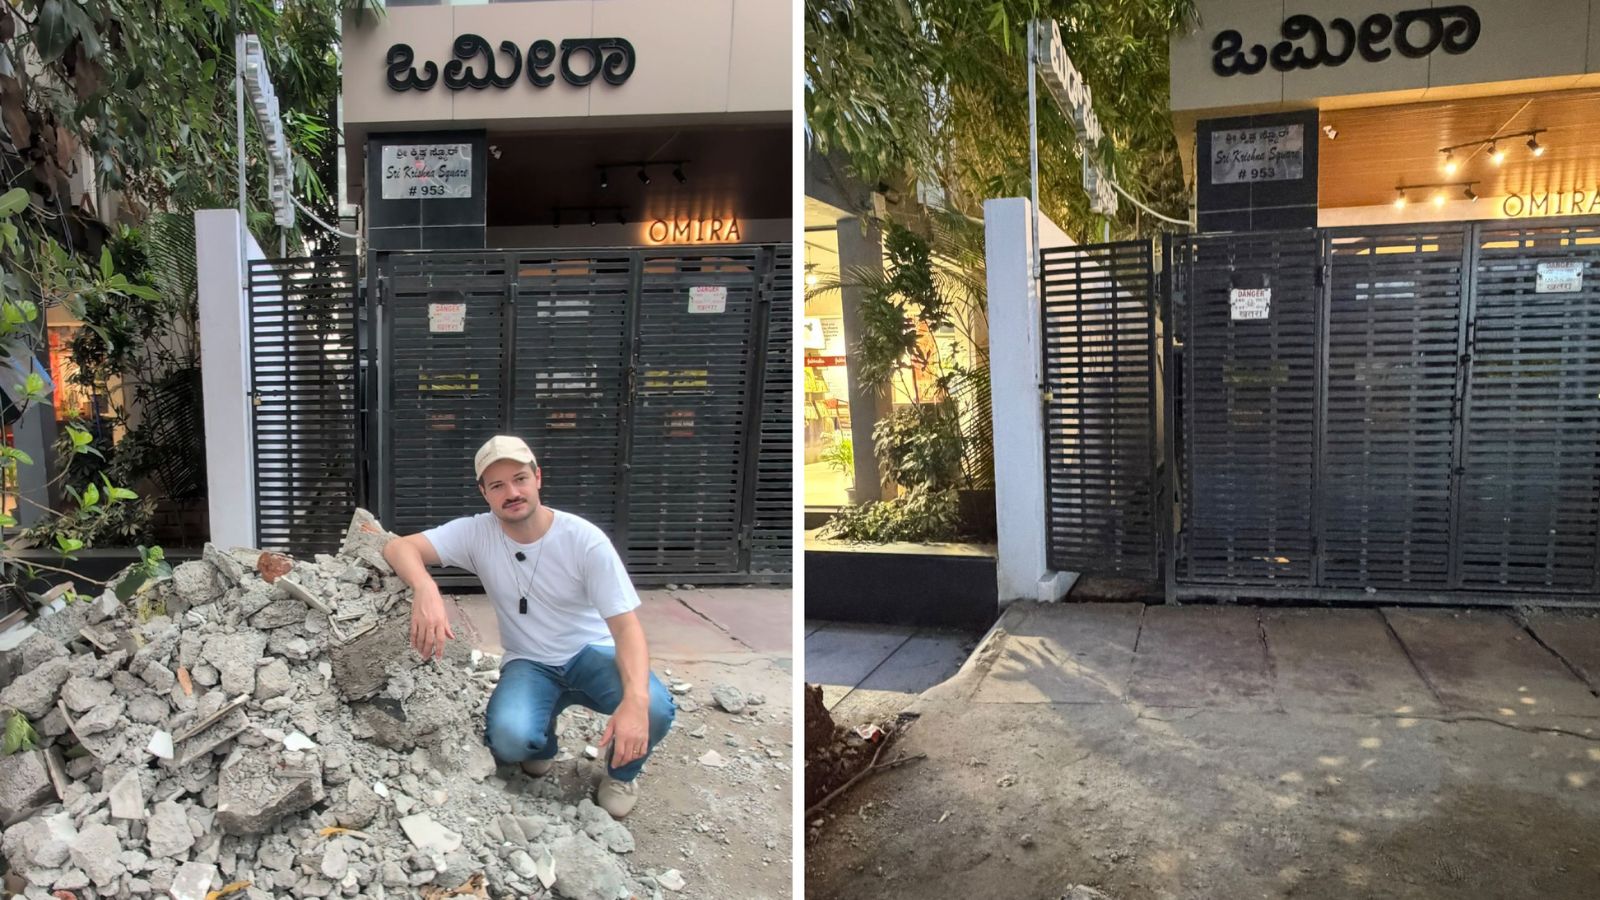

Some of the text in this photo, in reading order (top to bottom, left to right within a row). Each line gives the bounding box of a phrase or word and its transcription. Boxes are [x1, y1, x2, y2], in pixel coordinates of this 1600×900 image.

[1212, 5, 1481, 77] ಒಮೀರಾ
[387, 34, 636, 91] ಒಮೀರಾ
[1215, 146, 1300, 166] Sri Krishna Square
[386, 164, 468, 182] Sri Krishna Square
[1251, 167, 1275, 179] 953
[420, 185, 445, 196] 953
[1503, 189, 1600, 217] OMIRA
[649, 216, 741, 242] OMIRA
[1237, 290, 1265, 298] DANGER
